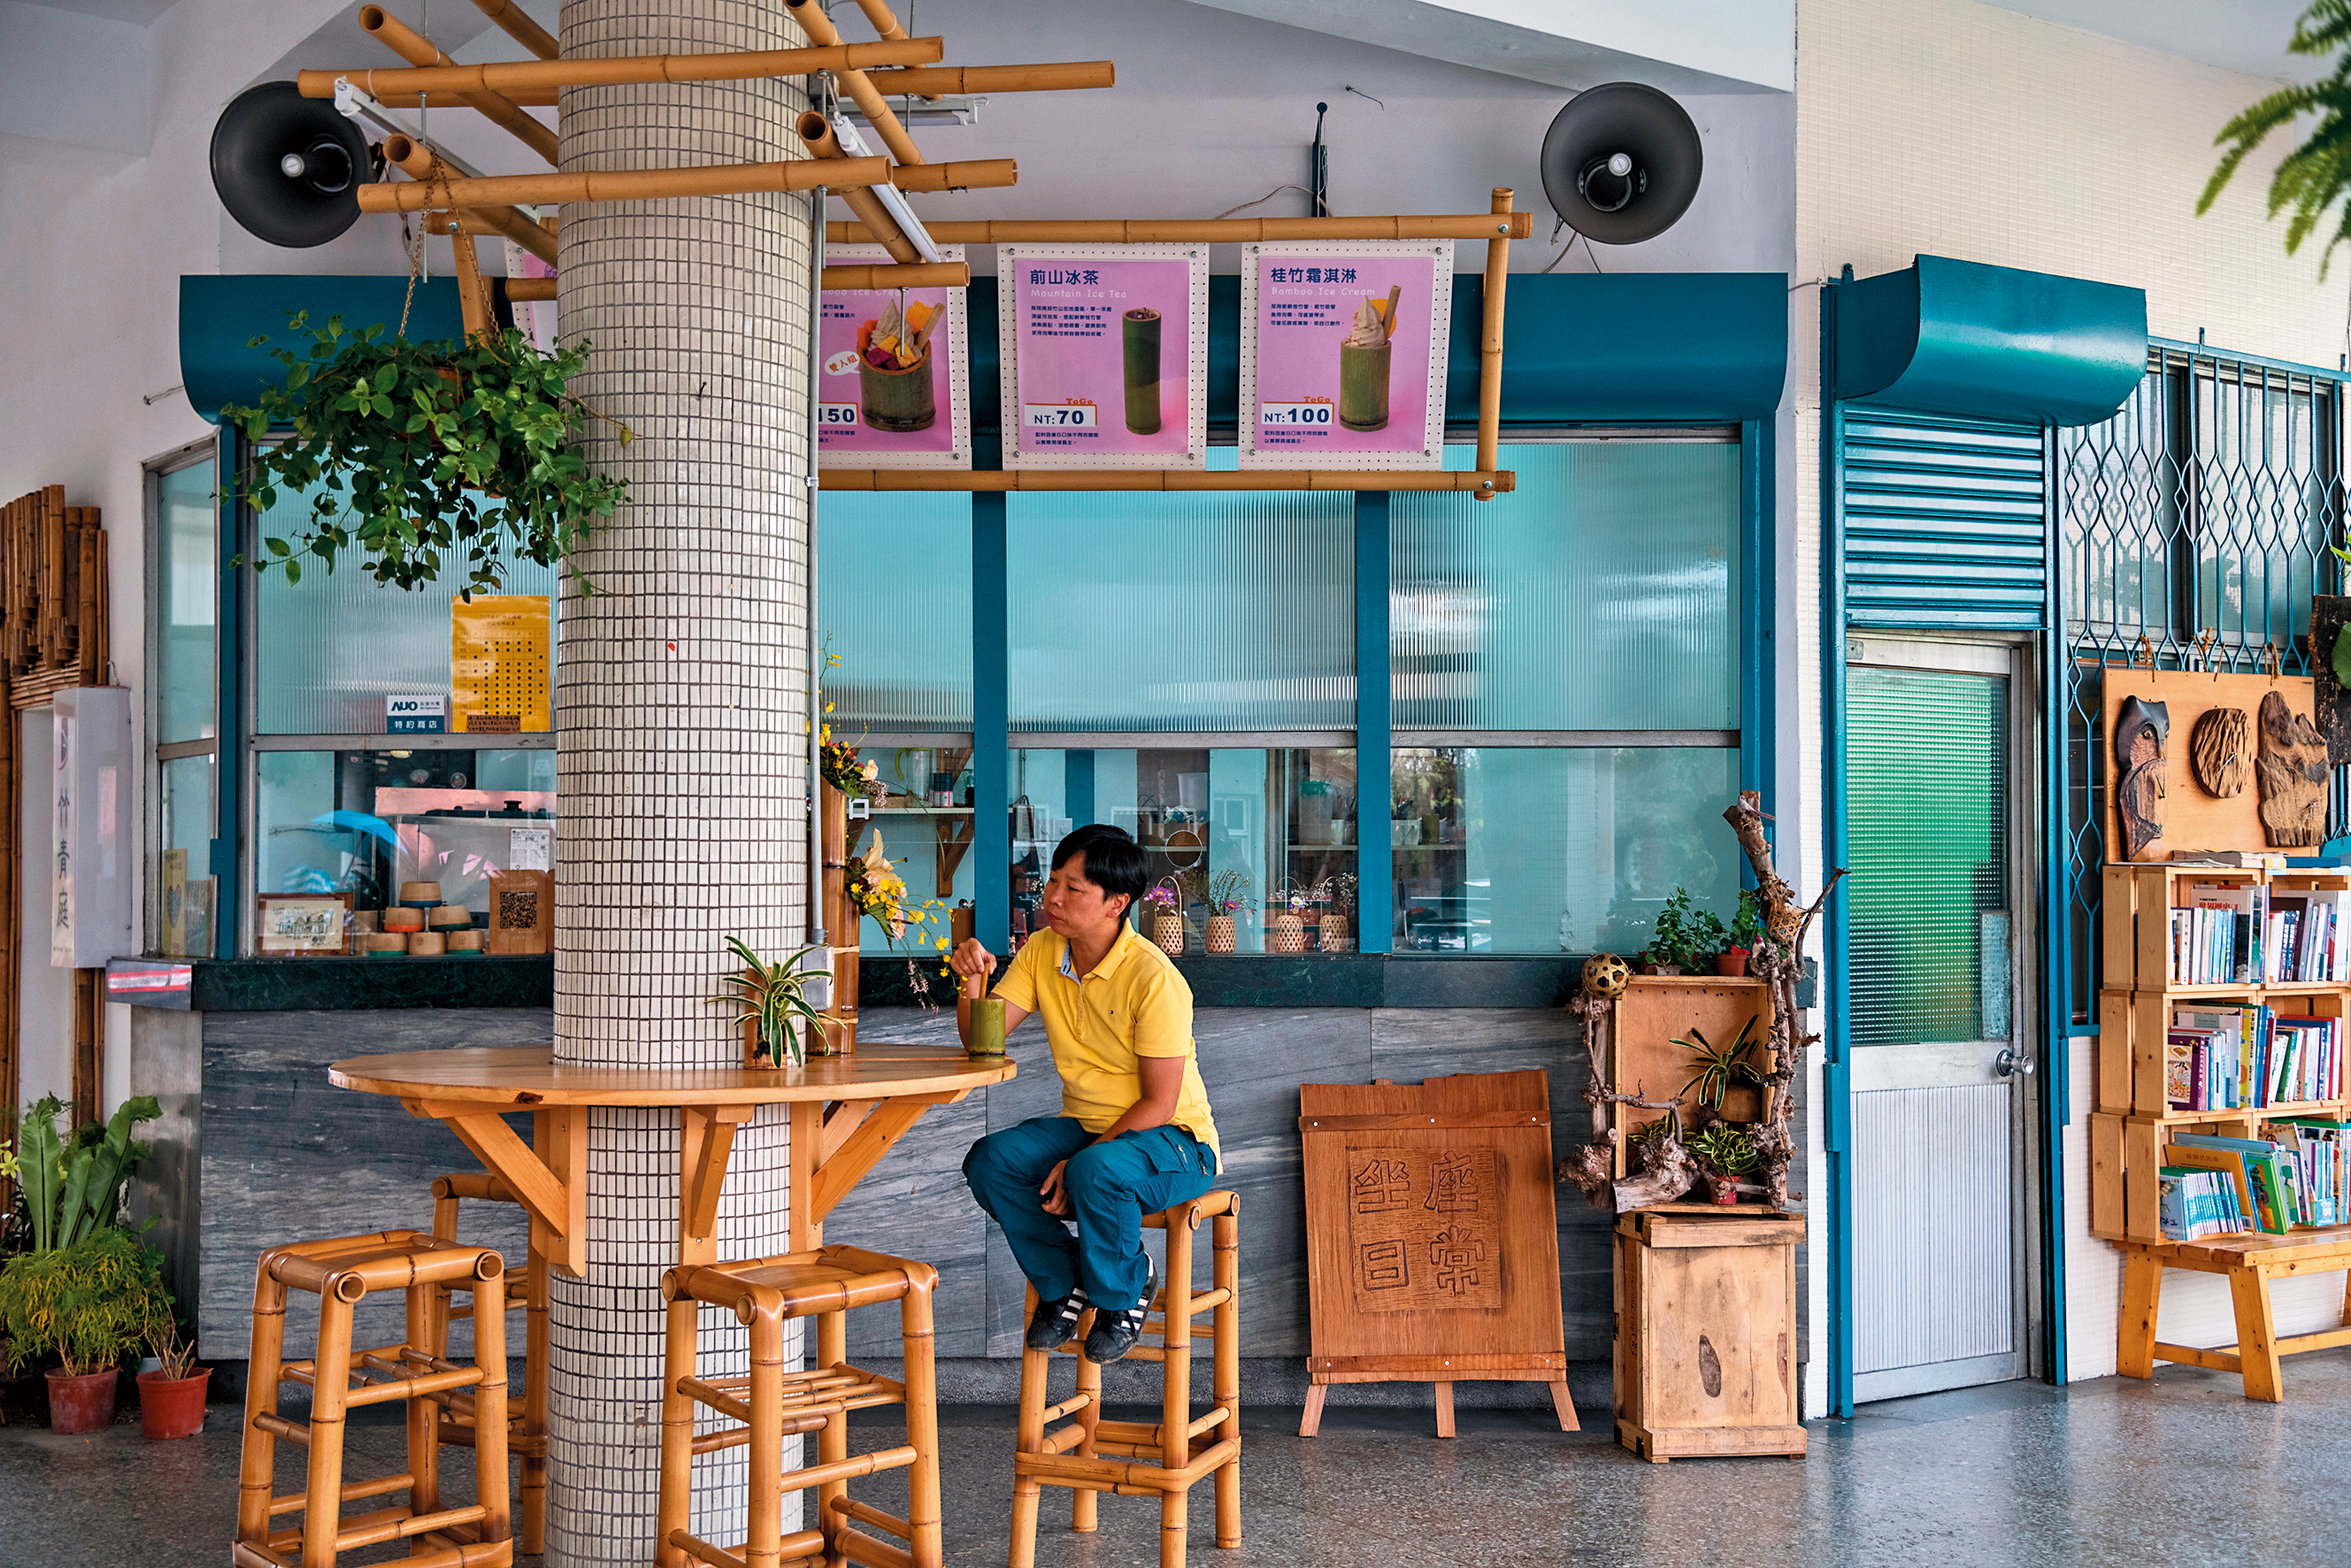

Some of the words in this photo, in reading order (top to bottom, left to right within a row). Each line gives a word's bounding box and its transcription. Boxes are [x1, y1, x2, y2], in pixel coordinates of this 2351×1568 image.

[1030, 269, 1099, 285] 前山冰茶
[1271, 267, 1357, 284] 桂竹霜淇淋
[1109, 289, 1127, 298] Tea
[1272, 286, 1313, 296] Bamboo
[1318, 287, 1335, 296] Ice
[829, 354, 857, 373] 雙人組
[391, 701, 418, 711] AUO
[395, 720, 437, 729] 特約商店
[57, 787, 70, 929] 竹青庭
